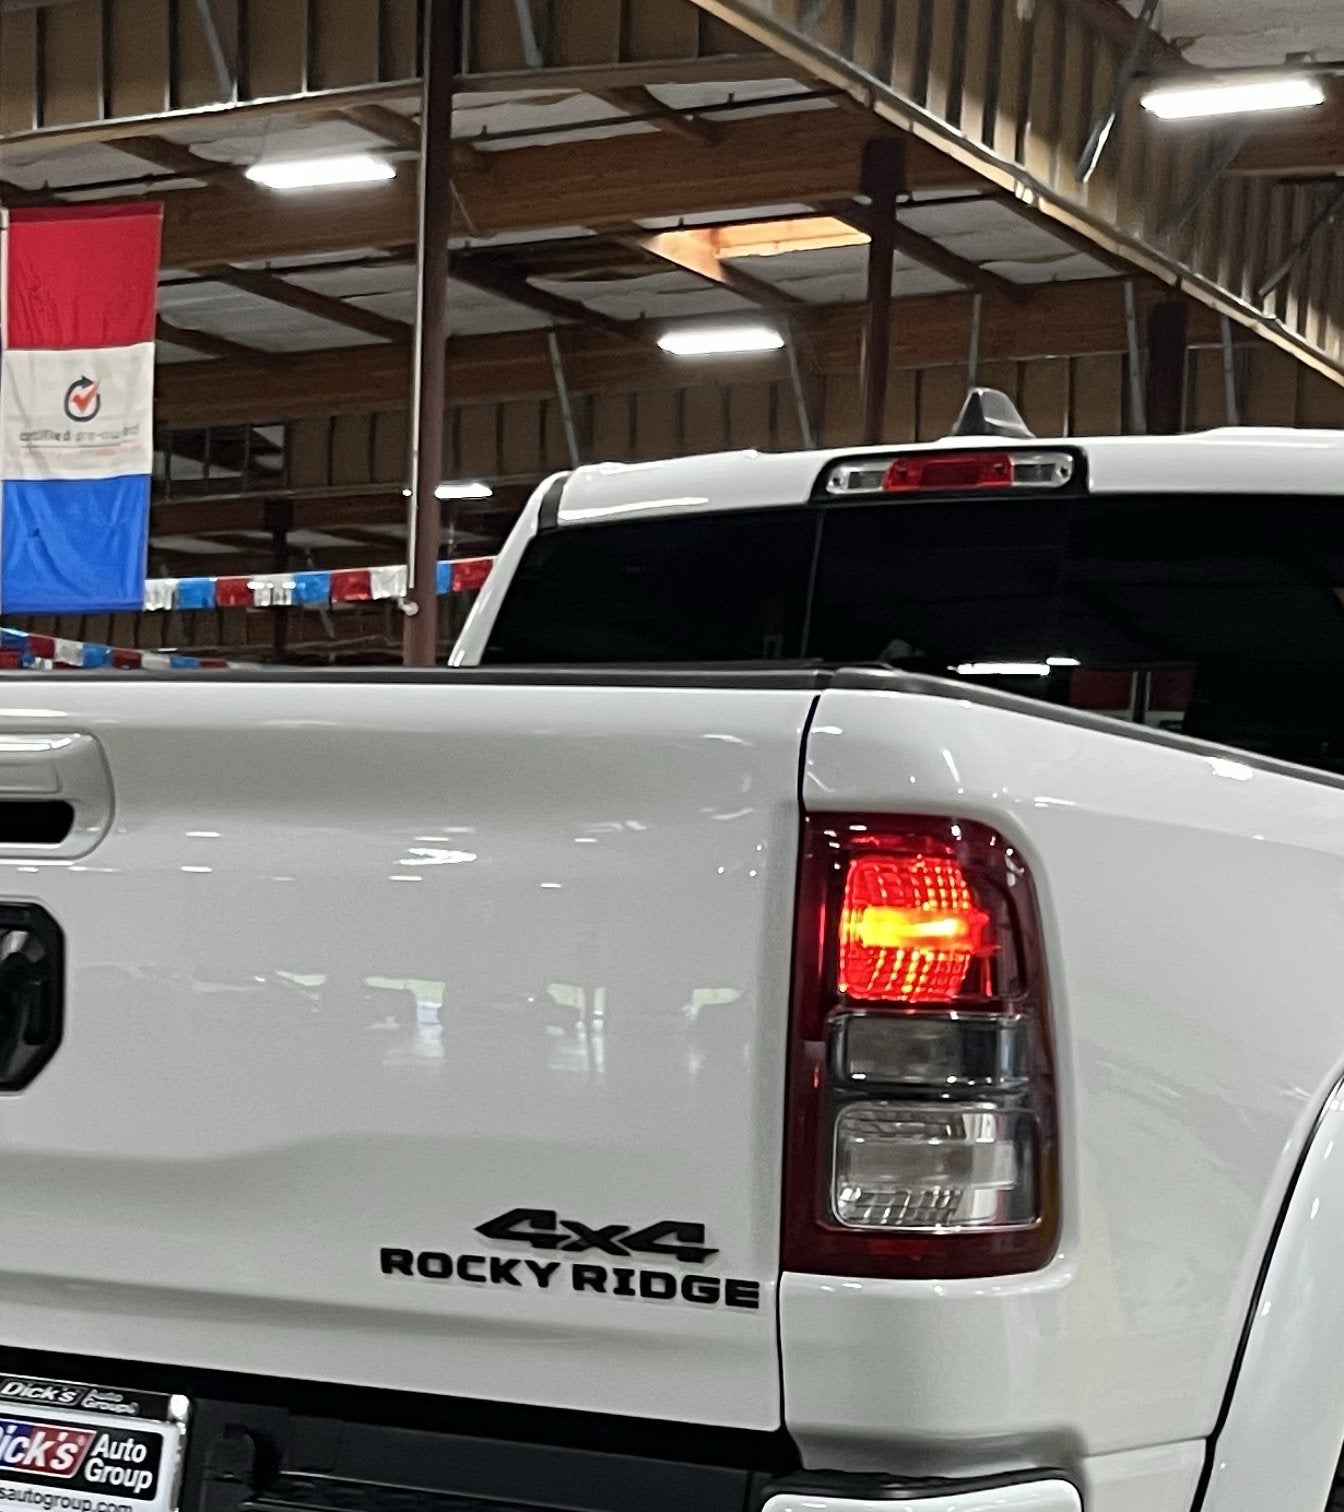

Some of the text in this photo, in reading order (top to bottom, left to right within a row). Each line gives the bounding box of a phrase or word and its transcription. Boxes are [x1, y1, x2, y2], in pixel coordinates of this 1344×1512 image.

[474, 1208, 720, 1263] 4x4
[380, 1247, 760, 1309] ROCKY RIDGE
[0, 1381, 78, 1404] Dick's
[90, 1433, 148, 1463] Auto
[84, 1458, 154, 1494] Group
